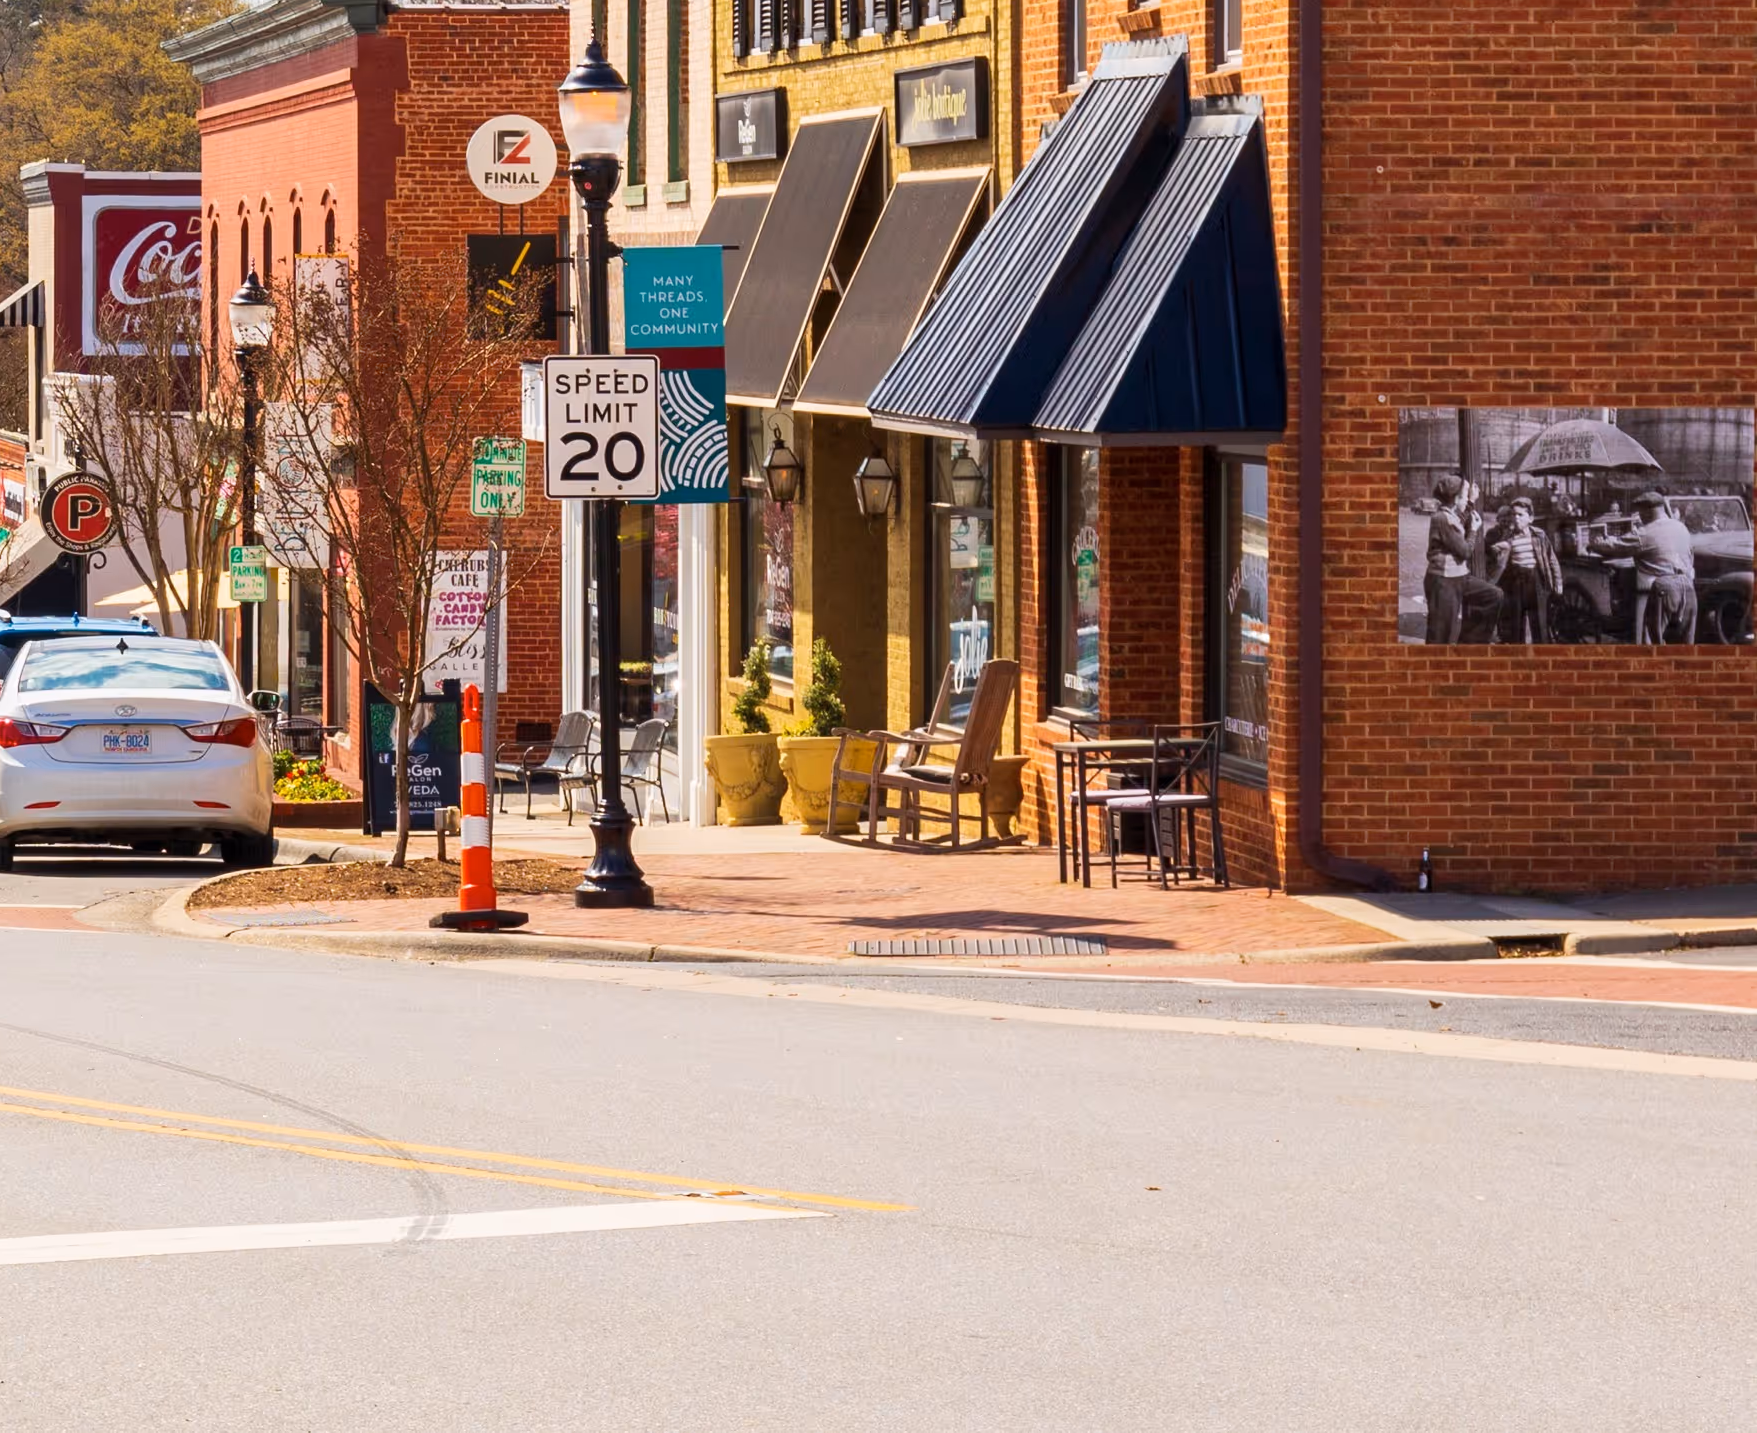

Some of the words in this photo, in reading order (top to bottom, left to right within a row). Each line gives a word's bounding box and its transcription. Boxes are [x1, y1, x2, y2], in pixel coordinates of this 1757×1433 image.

[485, 172, 539, 184] FINIAL
[653, 275, 693, 286] MANY
[659, 308, 689, 318] ONE
[630, 323, 718, 335] COMMUNITY
[555, 374, 649, 394] SPEED
[566, 403, 638, 423] LIMIT
[560, 431, 645, 481] 20
[1539, 450, 1591, 463] DRINKS
[54, 476, 79, 492] PUBLIC
[477, 470, 521, 487] PARKING
[68, 493, 102, 531] P
[56, 535, 65, 546] the
[65, 542, 84, 551] Shops
[233, 549, 241, 562] 2
[451, 574, 479, 587] CAFE
[103, 734, 150, 747] PHK-8024
